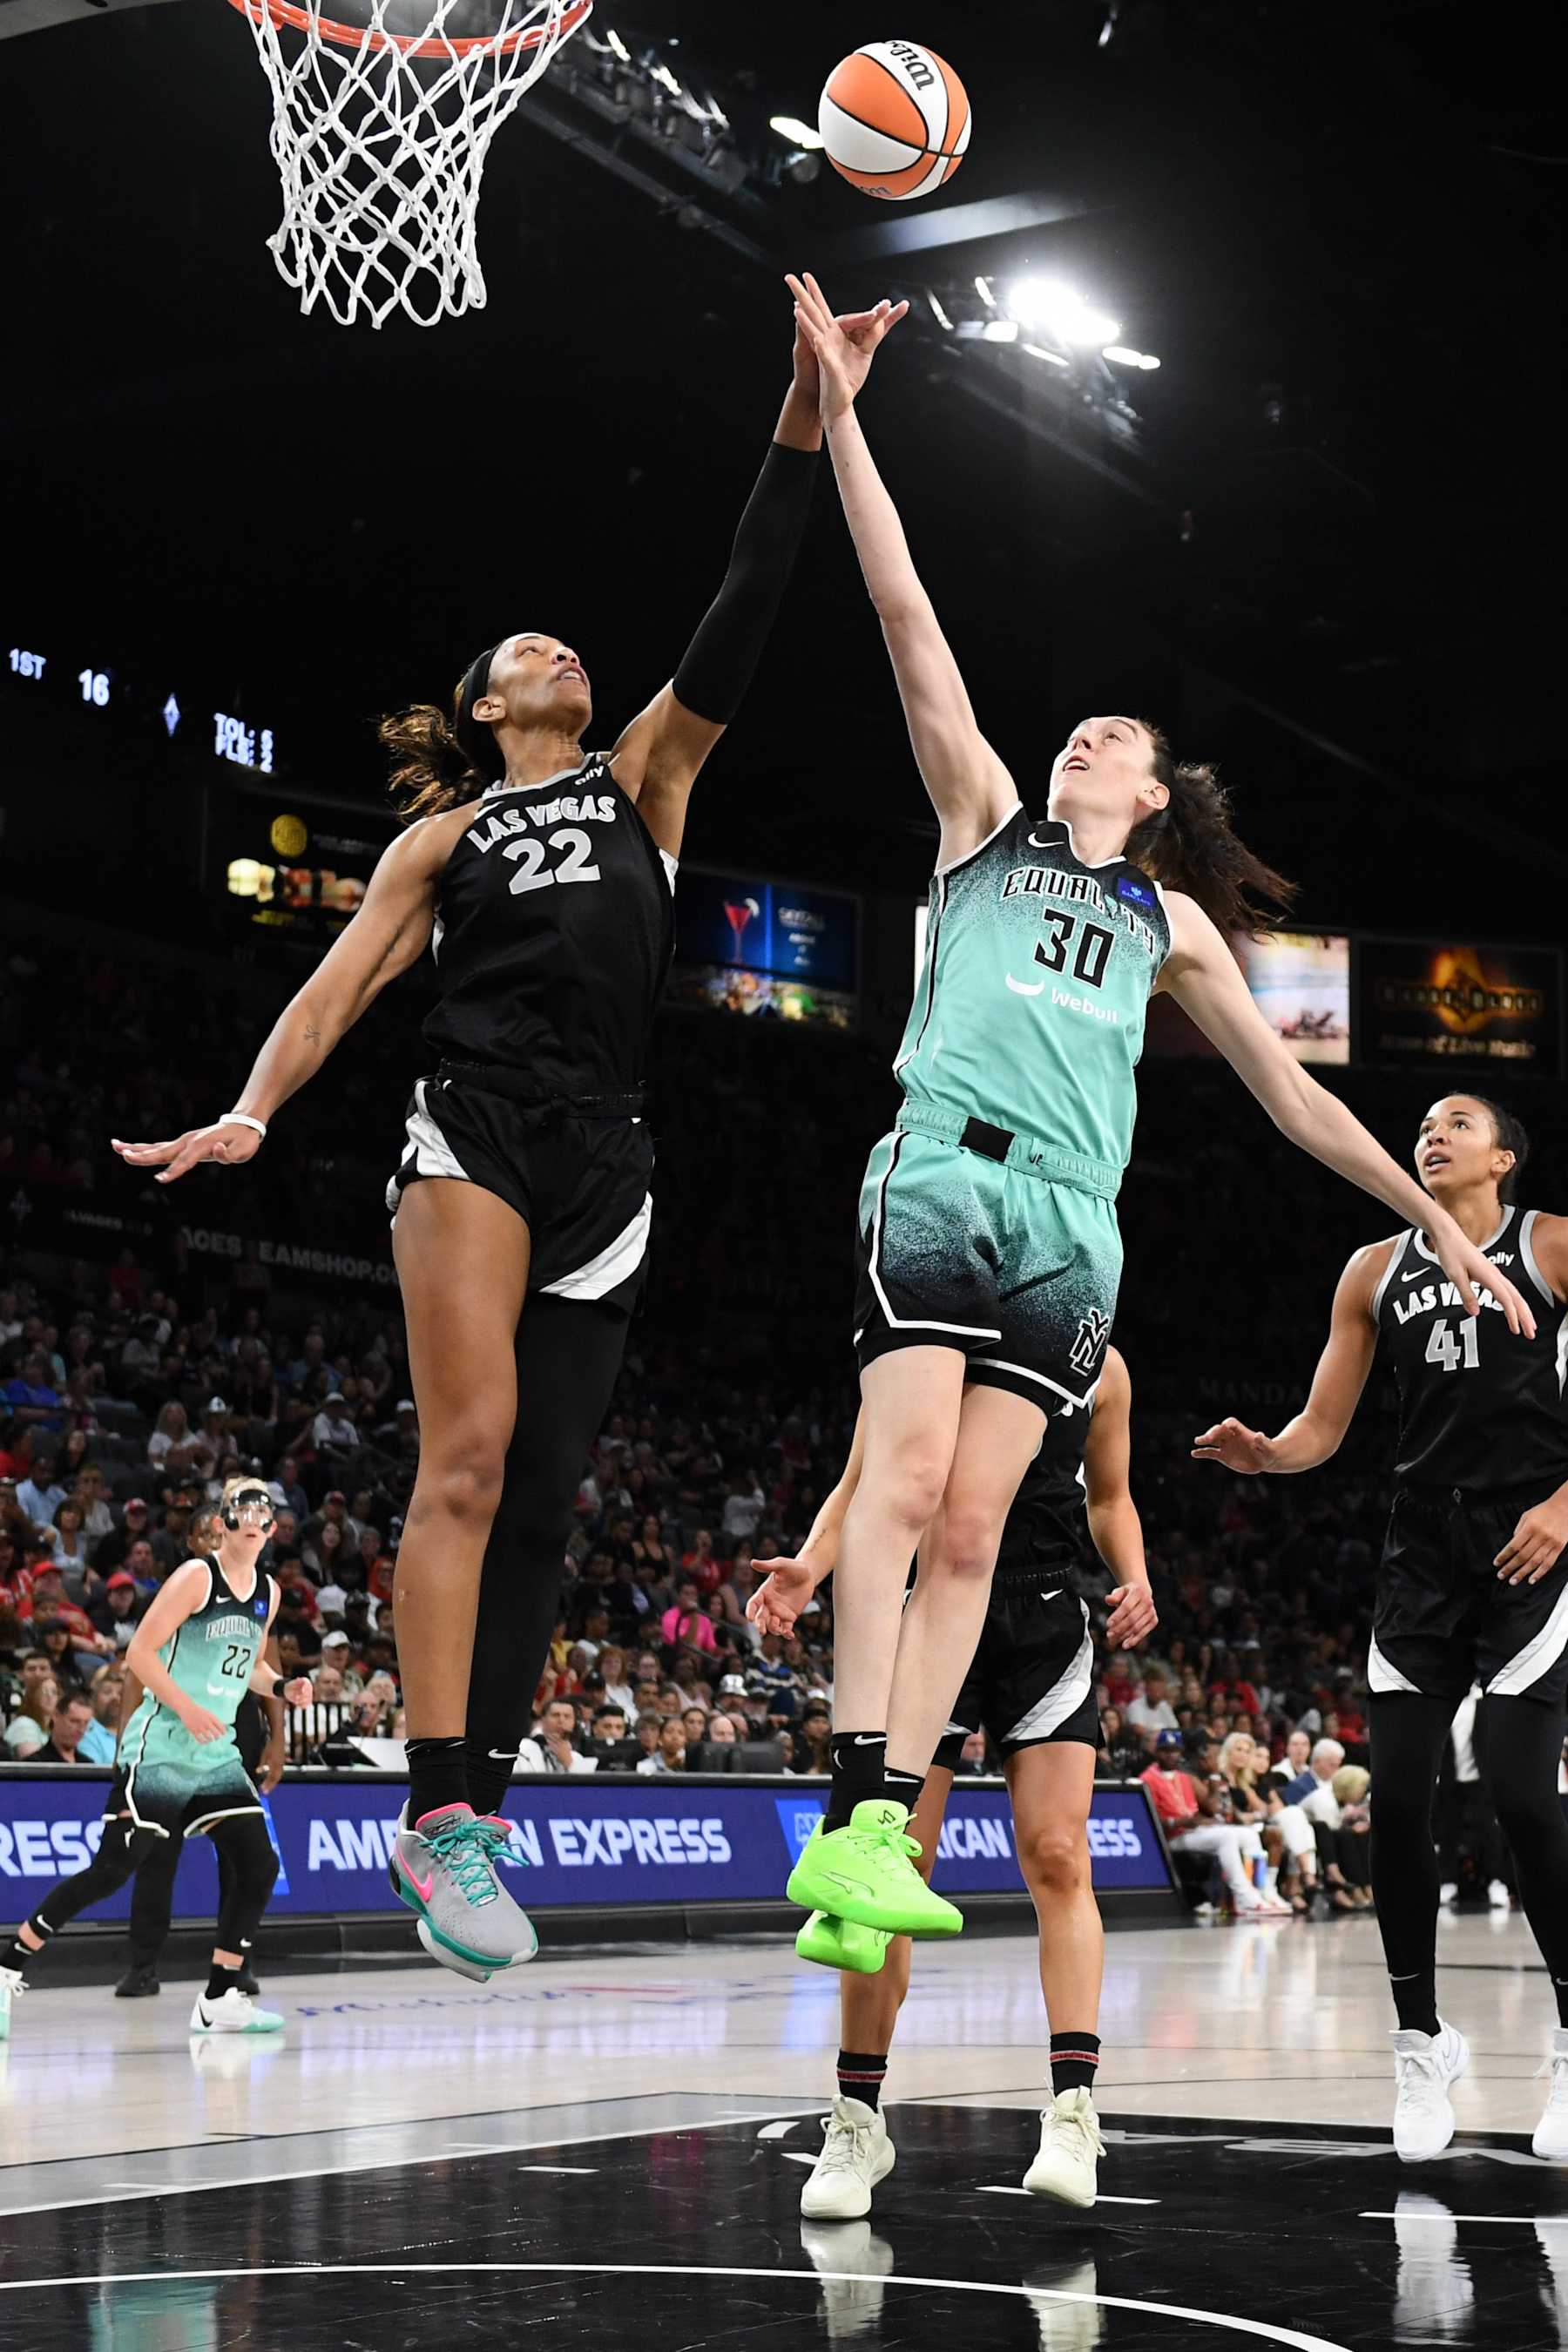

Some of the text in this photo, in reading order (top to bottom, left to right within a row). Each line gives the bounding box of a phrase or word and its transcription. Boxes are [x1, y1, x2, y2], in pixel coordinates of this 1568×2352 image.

[9, 647, 47, 680] 1ST
[78, 668, 110, 706] 16
[573, 765, 605, 787] ally
[466, 794, 617, 854] LAS VEGAS
[501, 828, 602, 896] 22
[1032, 907, 1115, 990] 30
[1051, 986, 1119, 1024] Webull
[258, 1240, 399, 1287] EAMSHOP.C
[1486, 1251, 1515, 1267] ally
[1392, 1285, 1437, 1325] LAS
[1424, 1315, 1481, 1372] 41
[220, 1644, 252, 1680] 22
[548, 1818, 732, 1866] EXPRESS
